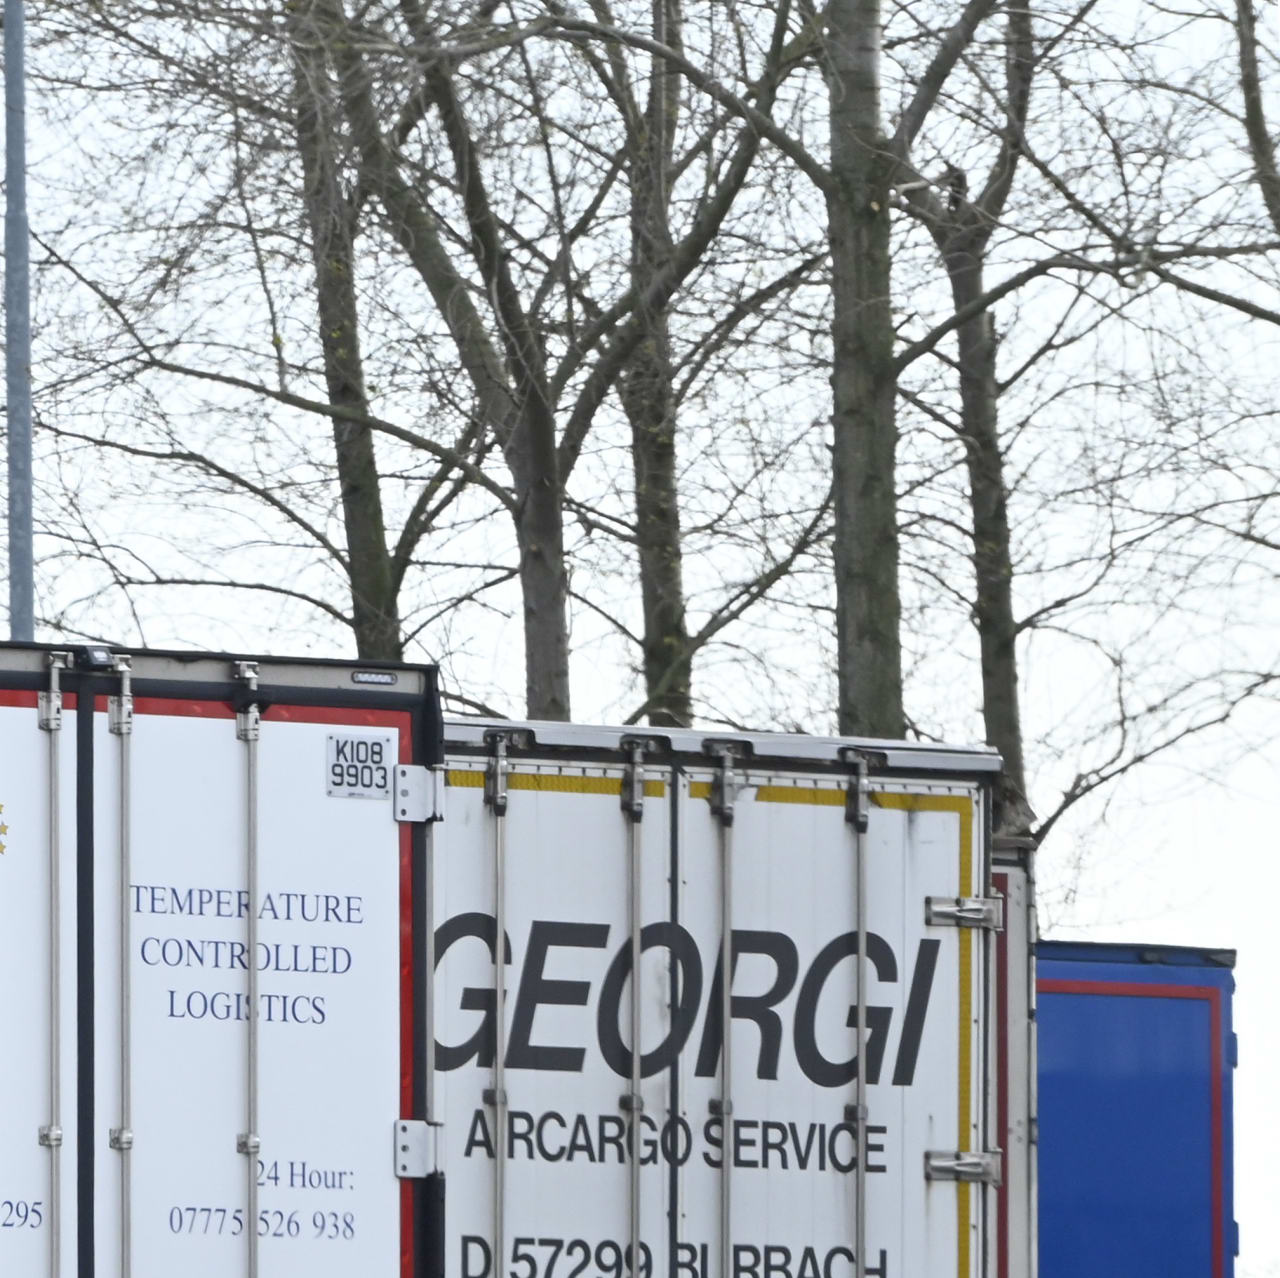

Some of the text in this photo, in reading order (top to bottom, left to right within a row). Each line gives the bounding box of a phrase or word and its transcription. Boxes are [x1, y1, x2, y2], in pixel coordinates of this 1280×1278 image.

[331, 763, 388, 789] 9903
[130, 885, 364, 924] TEMPERATURE
[141, 936, 352, 975] CONTROLLED
[433, 911, 942, 1088] GEORGI
[464, 1109, 888, 1173] ARCARGO SERVICE
[288, 1161, 355, 1190] Hour:
[169, 1206, 355, 1240] 07775 526 938
